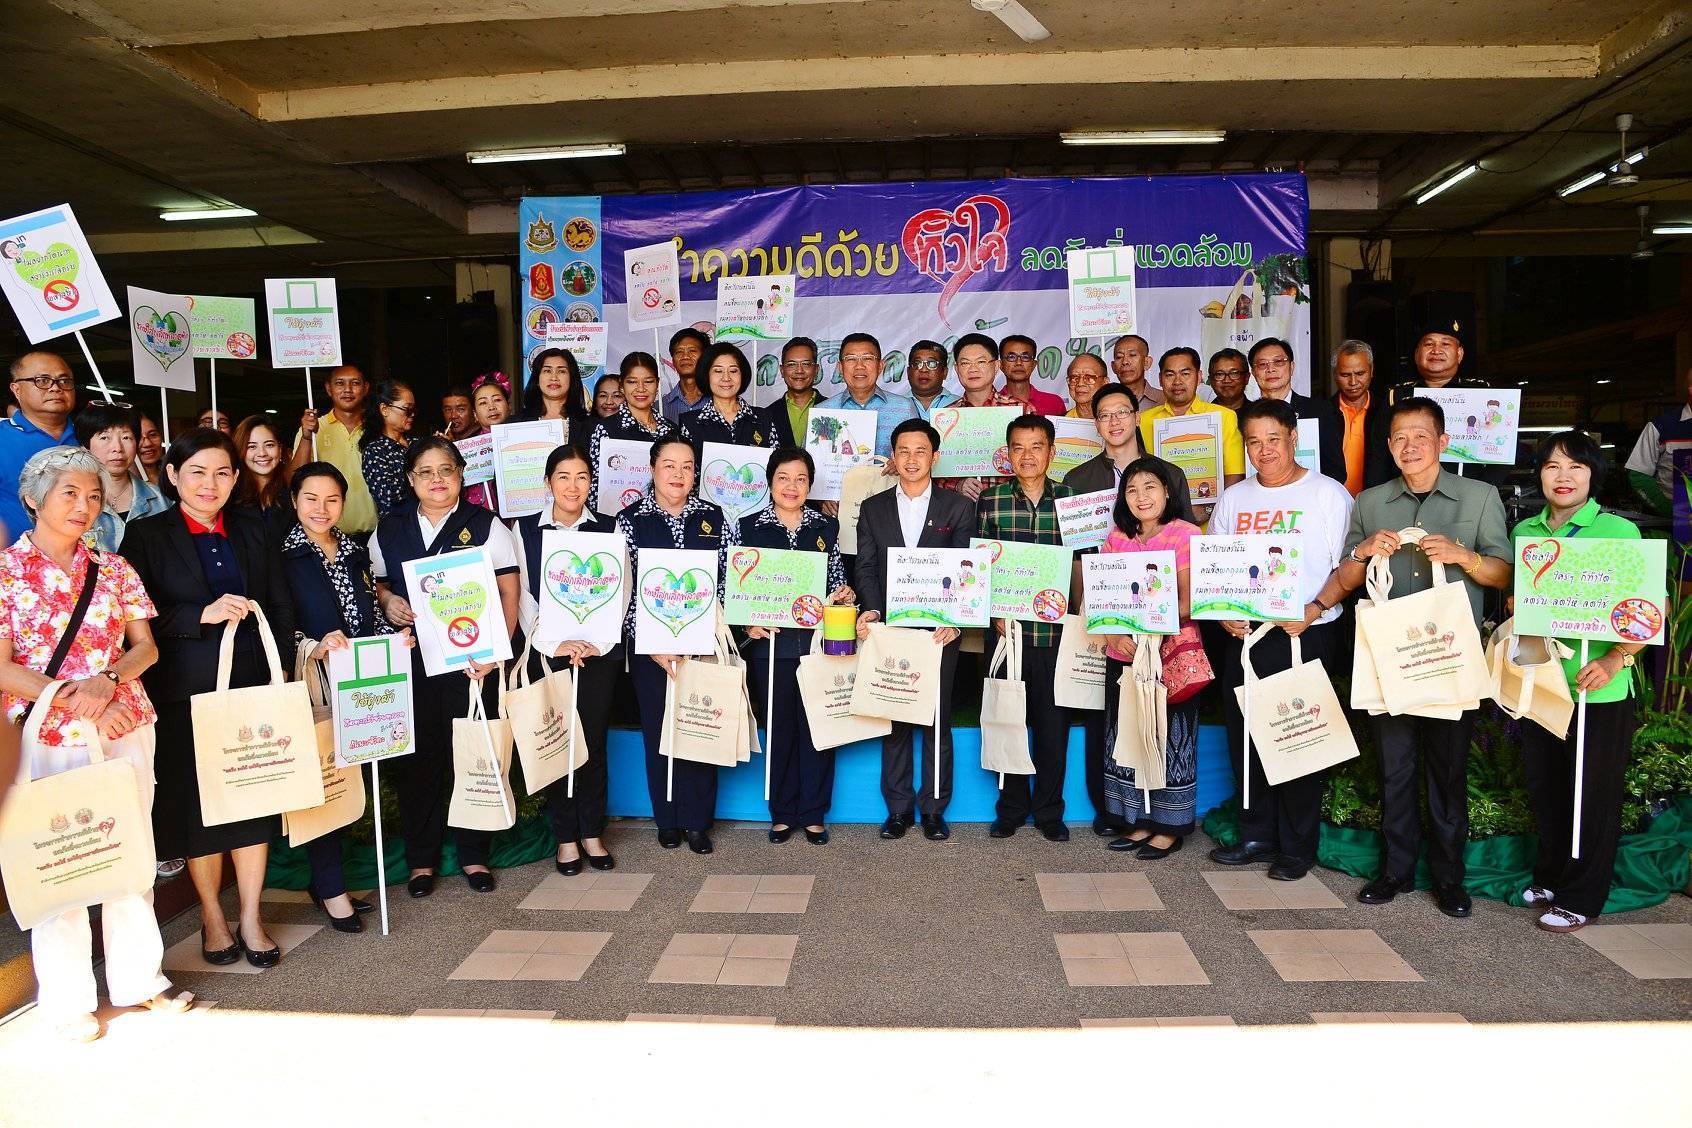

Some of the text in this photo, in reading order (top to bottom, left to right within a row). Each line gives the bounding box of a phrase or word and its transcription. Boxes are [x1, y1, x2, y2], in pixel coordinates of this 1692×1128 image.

[672, 229, 899, 283] ำความดีด้วย
[1236, 510, 1304, 532] BEAT
[1580, 568, 1615, 583] ก็ทำได้
[1523, 595, 1548, 606] ลดรับ
[1583, 595, 1610, 609] ลดใช้
[1551, 617, 1608, 634] ถุงพลาสติก
